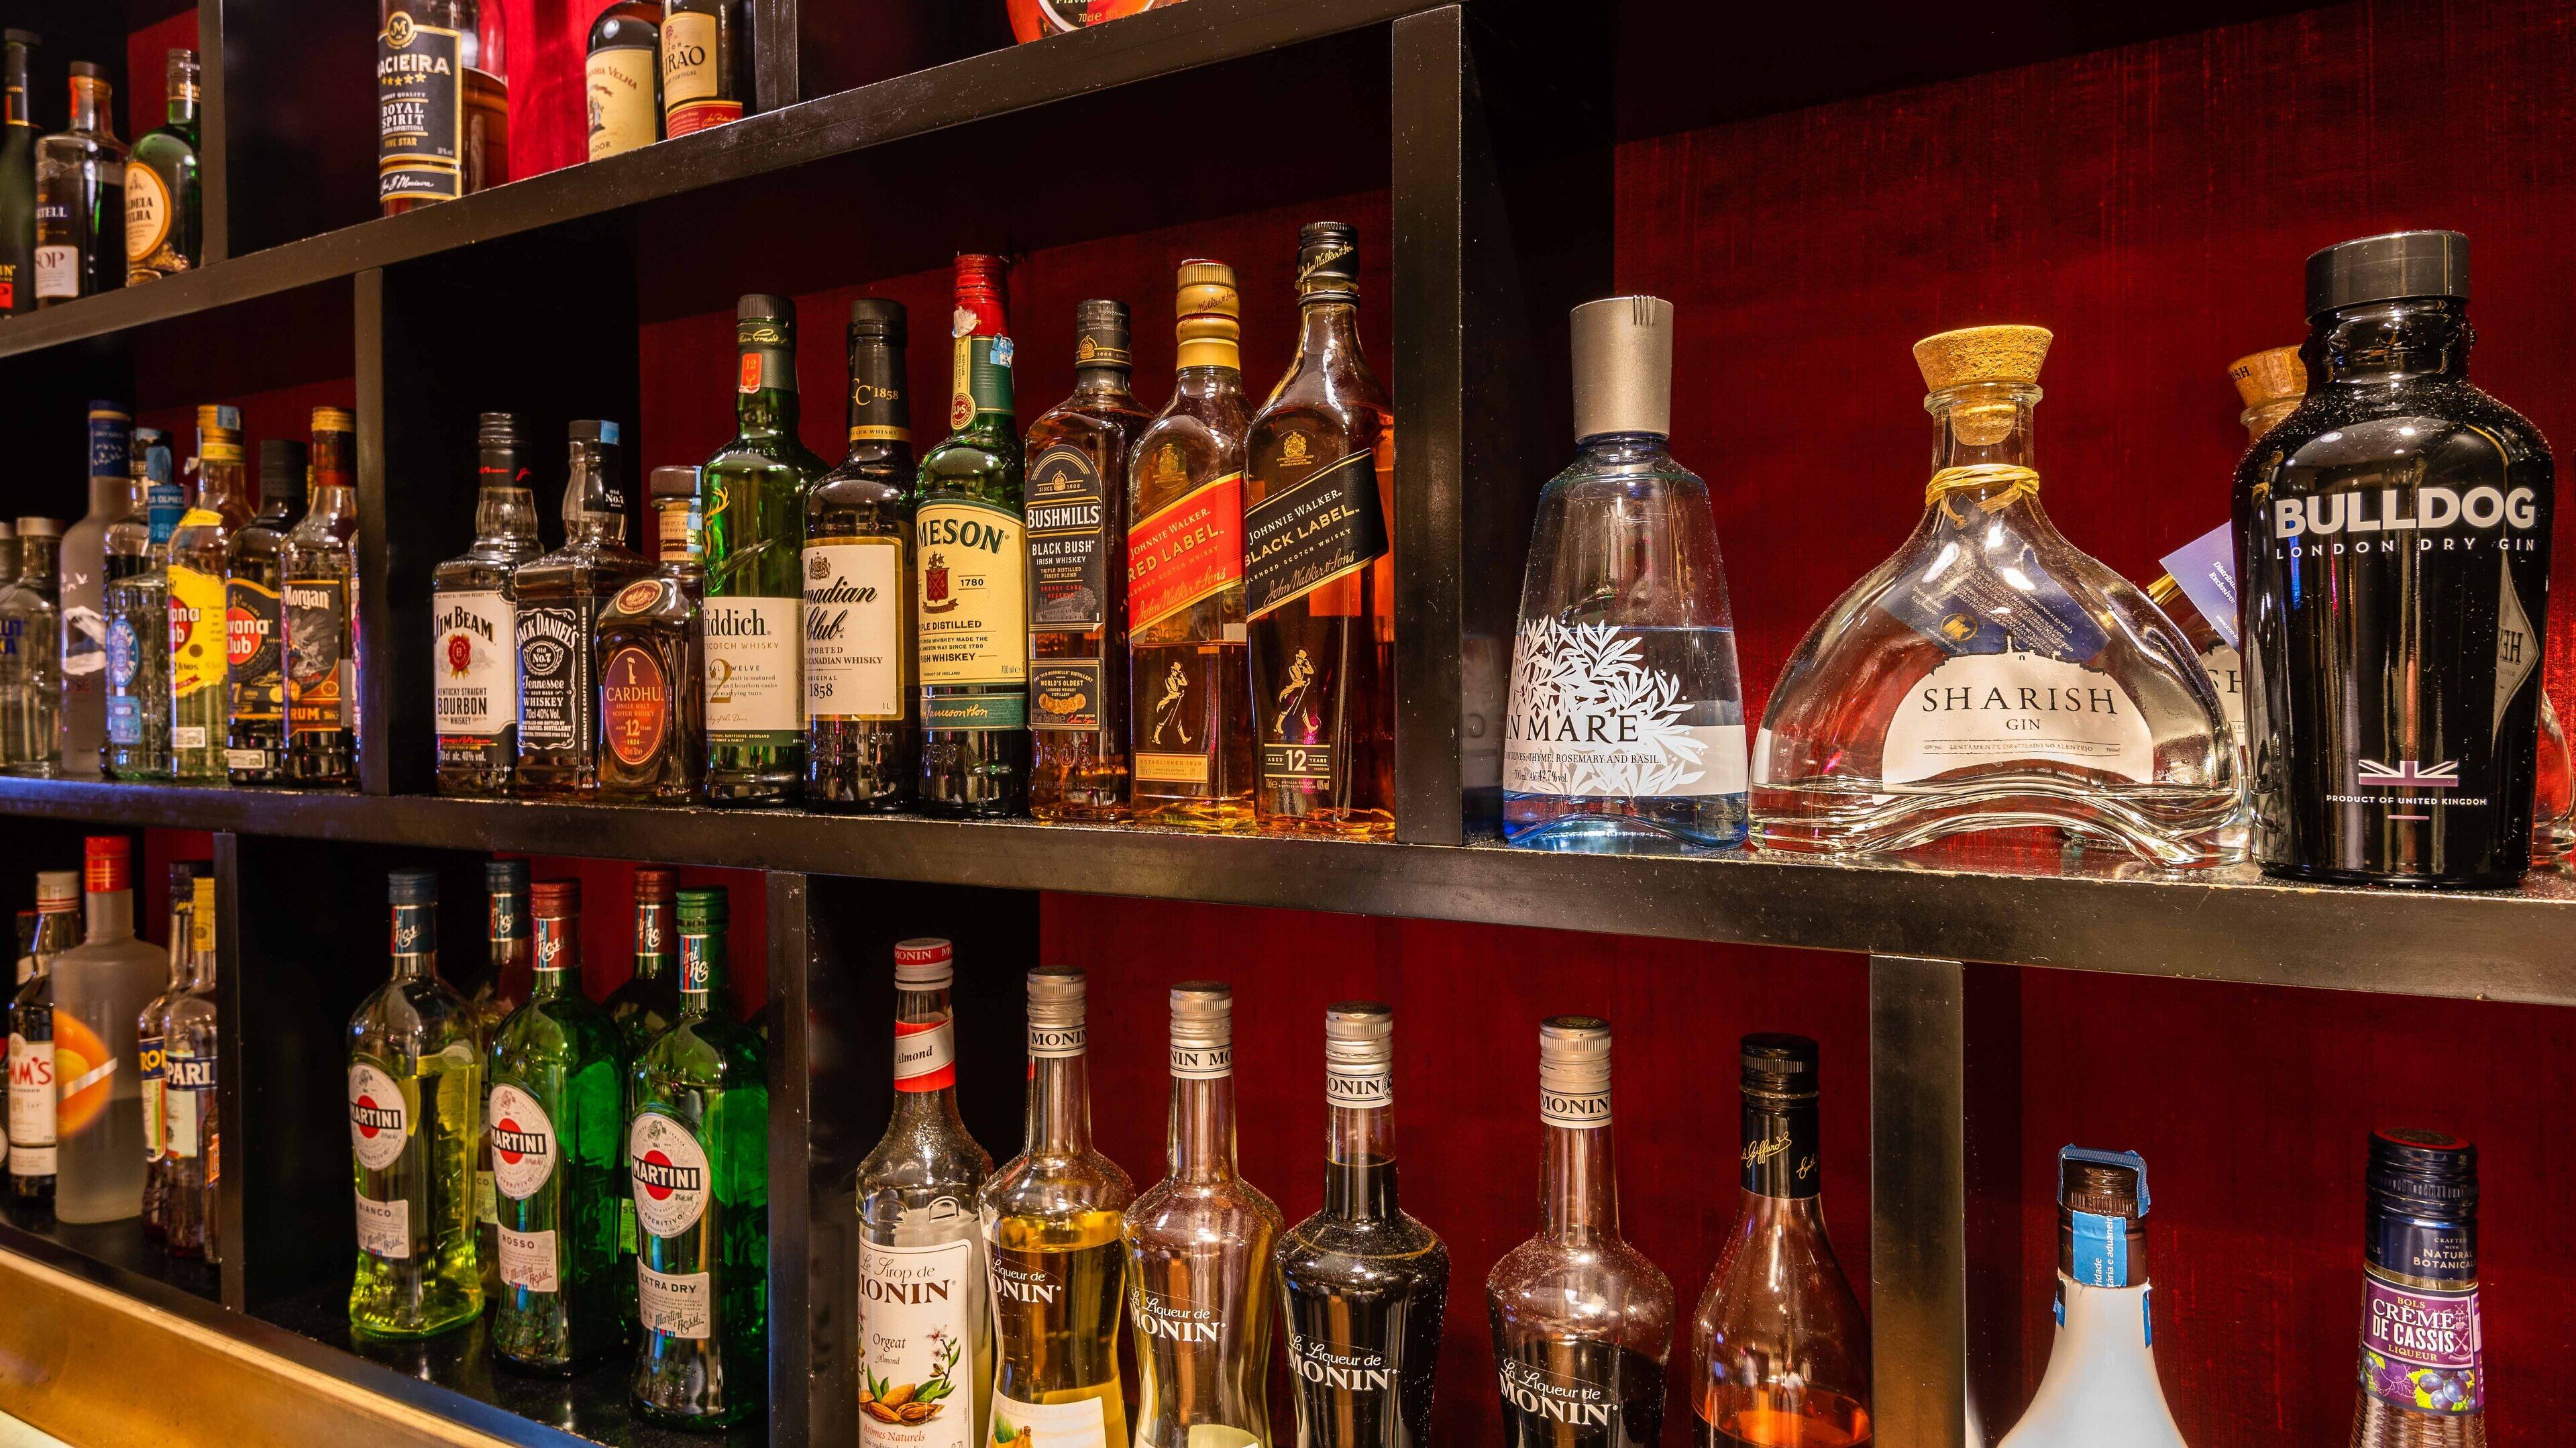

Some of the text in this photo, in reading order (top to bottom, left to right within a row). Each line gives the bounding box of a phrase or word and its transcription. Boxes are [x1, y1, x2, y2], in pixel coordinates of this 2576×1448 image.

[1079, 13, 1093, 22] 70cl
[609, 66, 637, 90] VELHA
[673, 70, 696, 81] PORTUGAL
[382, 103, 423, 117] ROYAL
[382, 114, 424, 128] SPIRIT
[398, 138, 417, 146] STAR
[745, 360, 756, 369] 12
[873, 388, 899, 400] 1858
[1028, 506, 1099, 528] BUSHMILLS
[1248, 490, 1339, 545] JOHNNIE WALKER
[2276, 487, 2534, 538] BULLDOG
[1130, 509, 1208, 560] JOHNNIE WALKER
[1246, 505, 1354, 568] BLACK LABEL
[1032, 540, 1091, 556] BLACK BUSH
[1128, 523, 1219, 582] RED LABEL
[1284, 529, 1350, 565] SCOTCH WHISKY
[2277, 538, 2534, 560] LONDON DRY GIN
[1159, 546, 1218, 580] SCOTCH WHISKY
[284, 585, 329, 610] Morgan
[2209, 572, 2235, 604] Exclusivo:
[455, 606, 494, 643] BEAM
[517, 612, 580, 649] JACK DANIEL'S
[805, 607, 848, 640] Club
[933, 621, 981, 629] DISTILLED
[533, 654, 551, 664] No.7
[932, 653, 975, 662] WHISKEY
[438, 687, 486, 696] KENTUCKY STRAIGHT
[523, 676, 564, 690] Tennessee
[810, 683, 833, 699] 1858
[523, 698, 564, 707] WHISKEY
[606, 687, 661, 701] CARDHU
[1923, 687, 2117, 715] SHARISH
[290, 709, 319, 719] RUM
[438, 698, 487, 715] BOURBON
[550, 709, 560, 719] Vol.
[450, 717, 471, 725] WHISKEY
[626, 719, 640, 736] 12
[1527, 714, 1638, 744] MARE
[2006, 719, 2040, 731] GIN
[462, 751, 486, 762] 40% vol.
[1285, 749, 1306, 771] 12
[1510, 753, 1661, 764] OLIVES, THYME, ROSEMARY AND BASIL.
[1558, 774, 1568, 782] vol.
[2327, 794, 2374, 803] PRODUCT
[897, 1045, 932, 1064] Almond
[1541, 1093, 1609, 1115] MONIN
[1747, 1133, 1788, 1168] Giffard
[633, 1155, 698, 1189] MARTINI
[360, 1201, 391, 1217] BIANCO
[502, 1234, 534, 1249] ROSSO
[2423, 1249, 2473, 1259] NATURAL
[874, 1257, 934, 1283] Sirop de
[991, 1257, 1045, 1282] Liqueur de
[641, 1273, 697, 1294] EXTRA DRY
[1142, 1296, 1210, 1318] Liqueur de
[2397, 1296, 2426, 1309] BOLS
[655, 1309, 682, 1327] Martini
[1129, 1302, 1220, 1342] MONIN
[2373, 1298, 2455, 1331] CRÈME
[873, 1333, 906, 1353] Orgeat
[2373, 1314, 2455, 1353] DE CASSIS
[1289, 1333, 1381, 1366] La Liqueur de
[2388, 1344, 2437, 1361] LIQUEUR
[875, 1355, 900, 1365] Almond
[1287, 1345, 1391, 1390] MONIN
[1501, 1358, 1601, 1400] La Liqueur de
[1499, 1372, 1612, 1427] MONIN
[864, 1424, 925, 1443] Arômes Naturels
